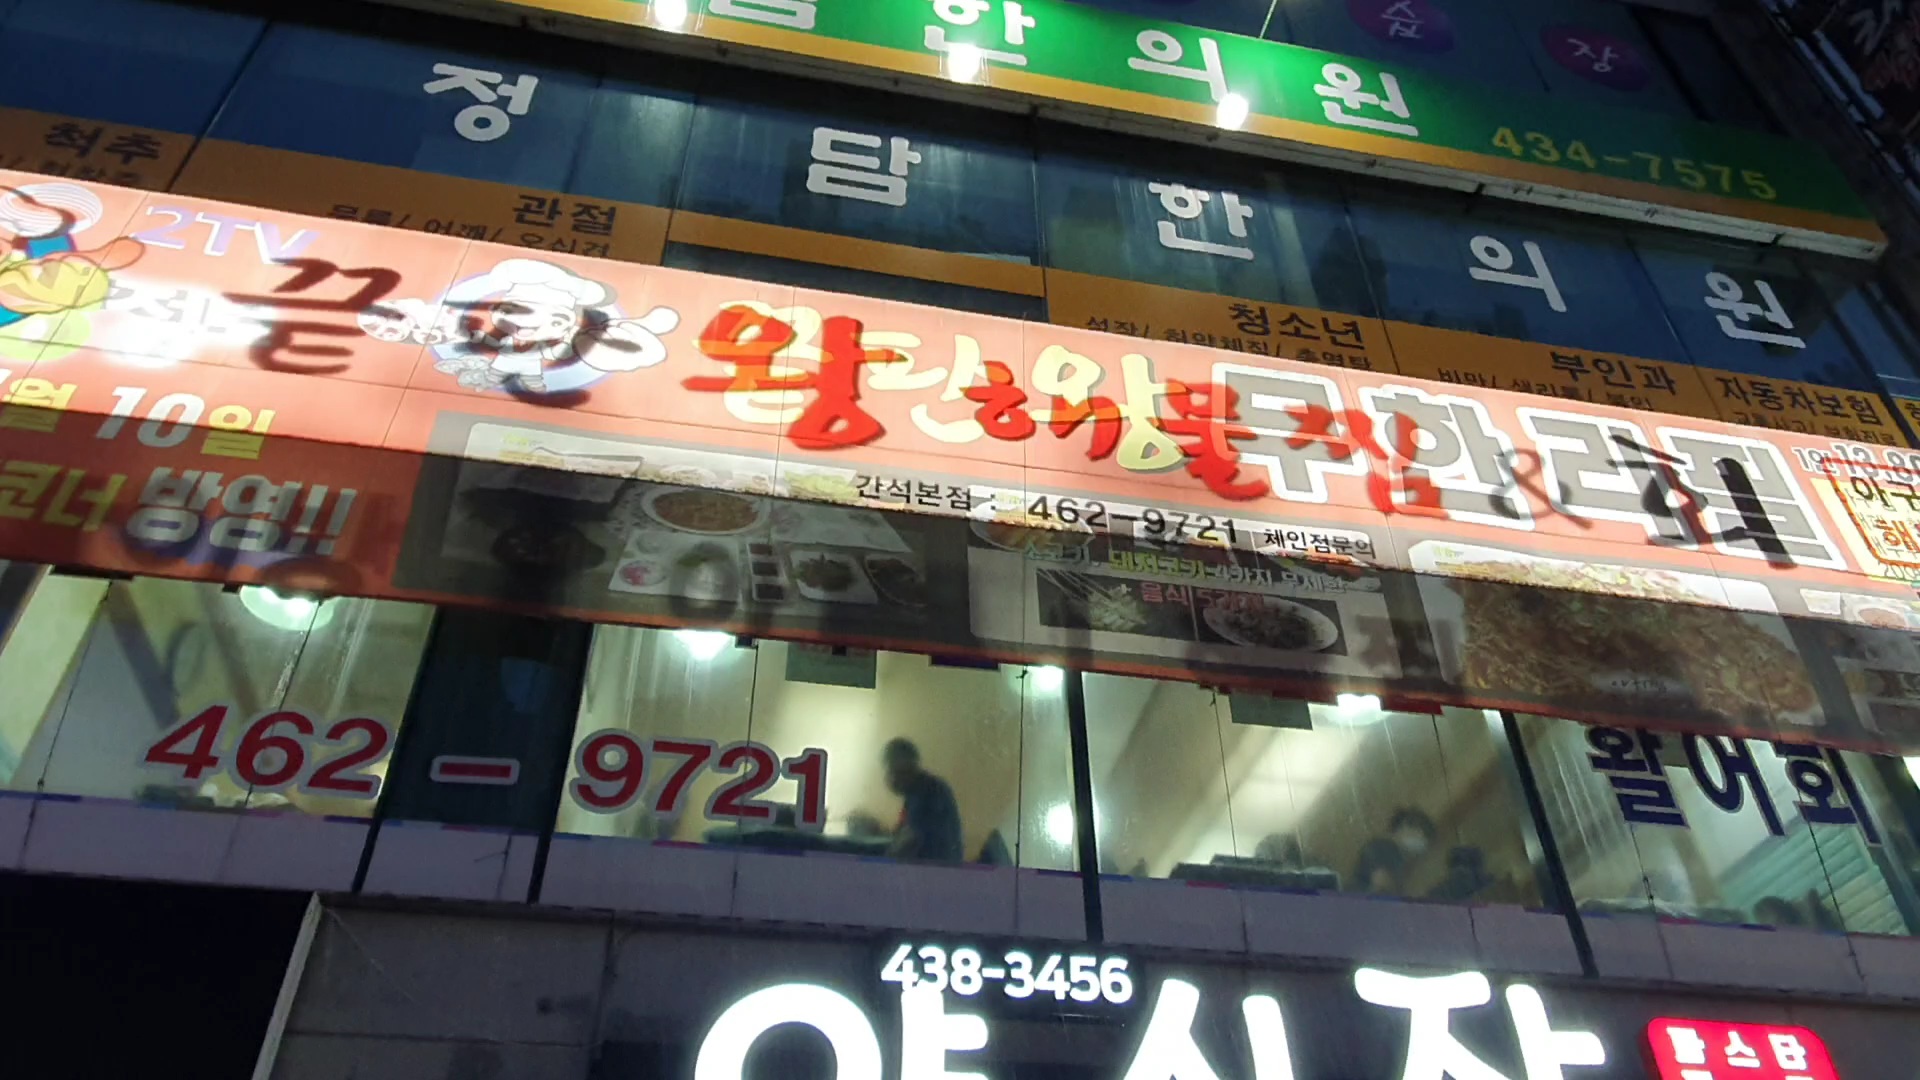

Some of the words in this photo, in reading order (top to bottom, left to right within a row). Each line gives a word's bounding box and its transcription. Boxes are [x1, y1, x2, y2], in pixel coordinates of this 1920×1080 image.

[1492, 125, 1777, 200] 434-7575
[127, 203, 323, 265] 2TV
[512, 194, 617, 236] 관절
[1229, 303, 1365, 350] 청소년
[1550, 351, 1676, 396] 부인과
[1715, 376, 1883, 427] 자동차보험
[95, 386, 276, 459] 10일
[1212, 362, 1849, 571] 무한리필
[126, 466, 358, 555] 방영!!
[855, 474, 972, 512] 간석본점
[1027, 495, 1237, 543] 462-9721
[1263, 528, 1377, 560] 체인점문의
[144, 704, 829, 828] 462-9721
[880, 943, 1133, 1004] 438-3456
